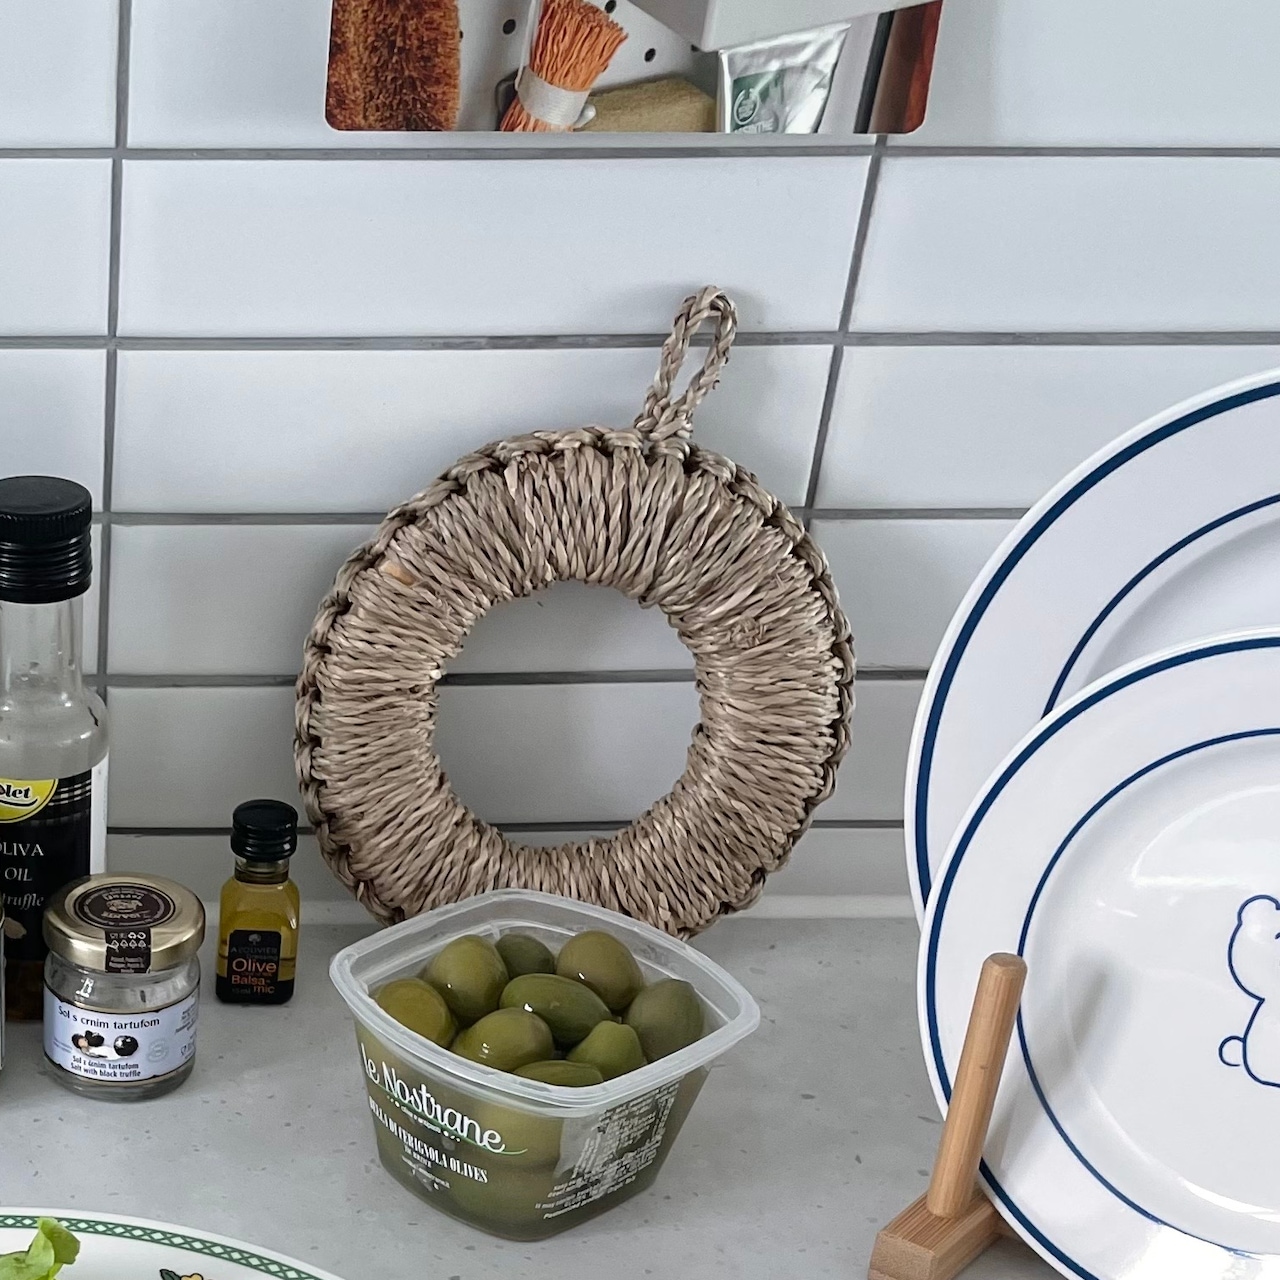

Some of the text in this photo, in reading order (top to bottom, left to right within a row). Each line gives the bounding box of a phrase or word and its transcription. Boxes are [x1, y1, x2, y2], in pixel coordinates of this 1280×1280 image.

[0, 841, 44, 857] LIVA
[4, 866, 33, 882] OIL
[232, 957, 277, 973] Olive
[253, 985, 275, 994] mic
[113, 1017, 160, 1030] tartufom
[382, 1061, 506, 1153] Nostrane
[450, 1157, 488, 1184] OLIVES
